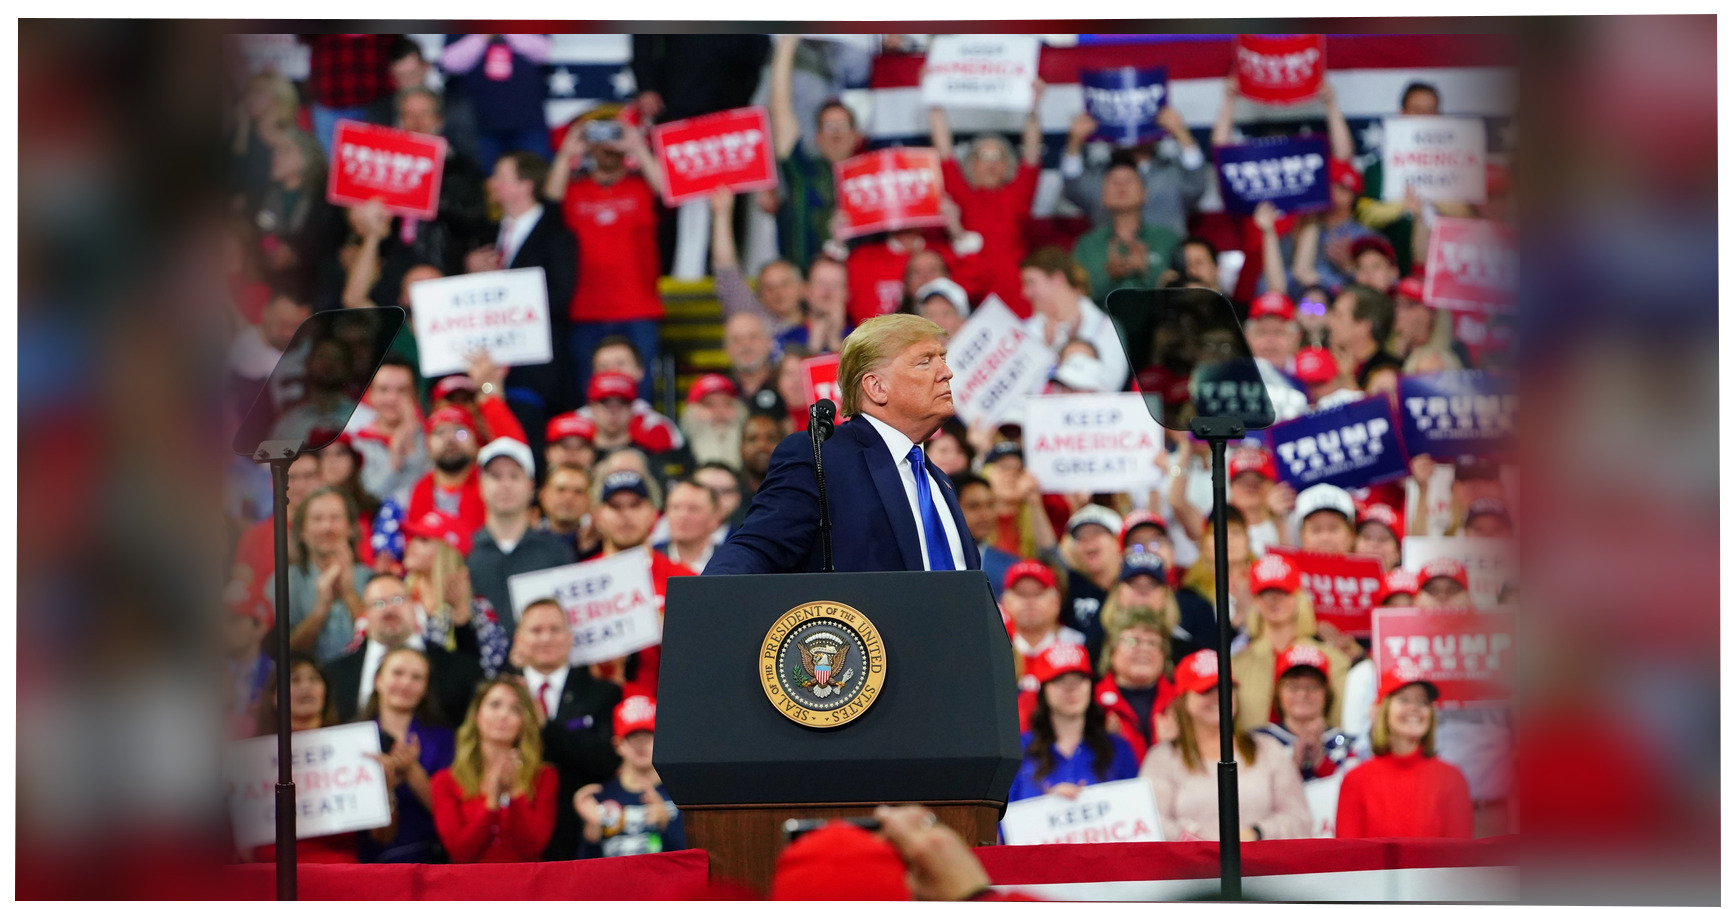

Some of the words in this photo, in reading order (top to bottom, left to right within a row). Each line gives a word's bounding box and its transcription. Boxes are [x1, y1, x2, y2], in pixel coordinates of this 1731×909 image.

[1222, 153, 1324, 183] TRUMP
[428, 305, 539, 335] AMERICA
[957, 325, 1026, 405] AMERICA
[1062, 408, 1122, 427] KEEP
[1035, 431, 1152, 452] AMERICA
[1277, 417, 1389, 464] TRUMP
[567, 588, 646, 626] ERICA
[825, 606, 838, 615] OF
[840, 609, 856, 623] THE
[764, 605, 822, 660] PRESIDENT
[1384, 633, 1512, 658] TRUMP
[857, 623, 883, 674] UNITED
[765, 664, 775, 682] THE
[769, 684, 780, 695] OF
[778, 695, 810, 721] SEAL
[831, 685, 876, 722] STATES
[1048, 801, 1111, 826] KEEP
